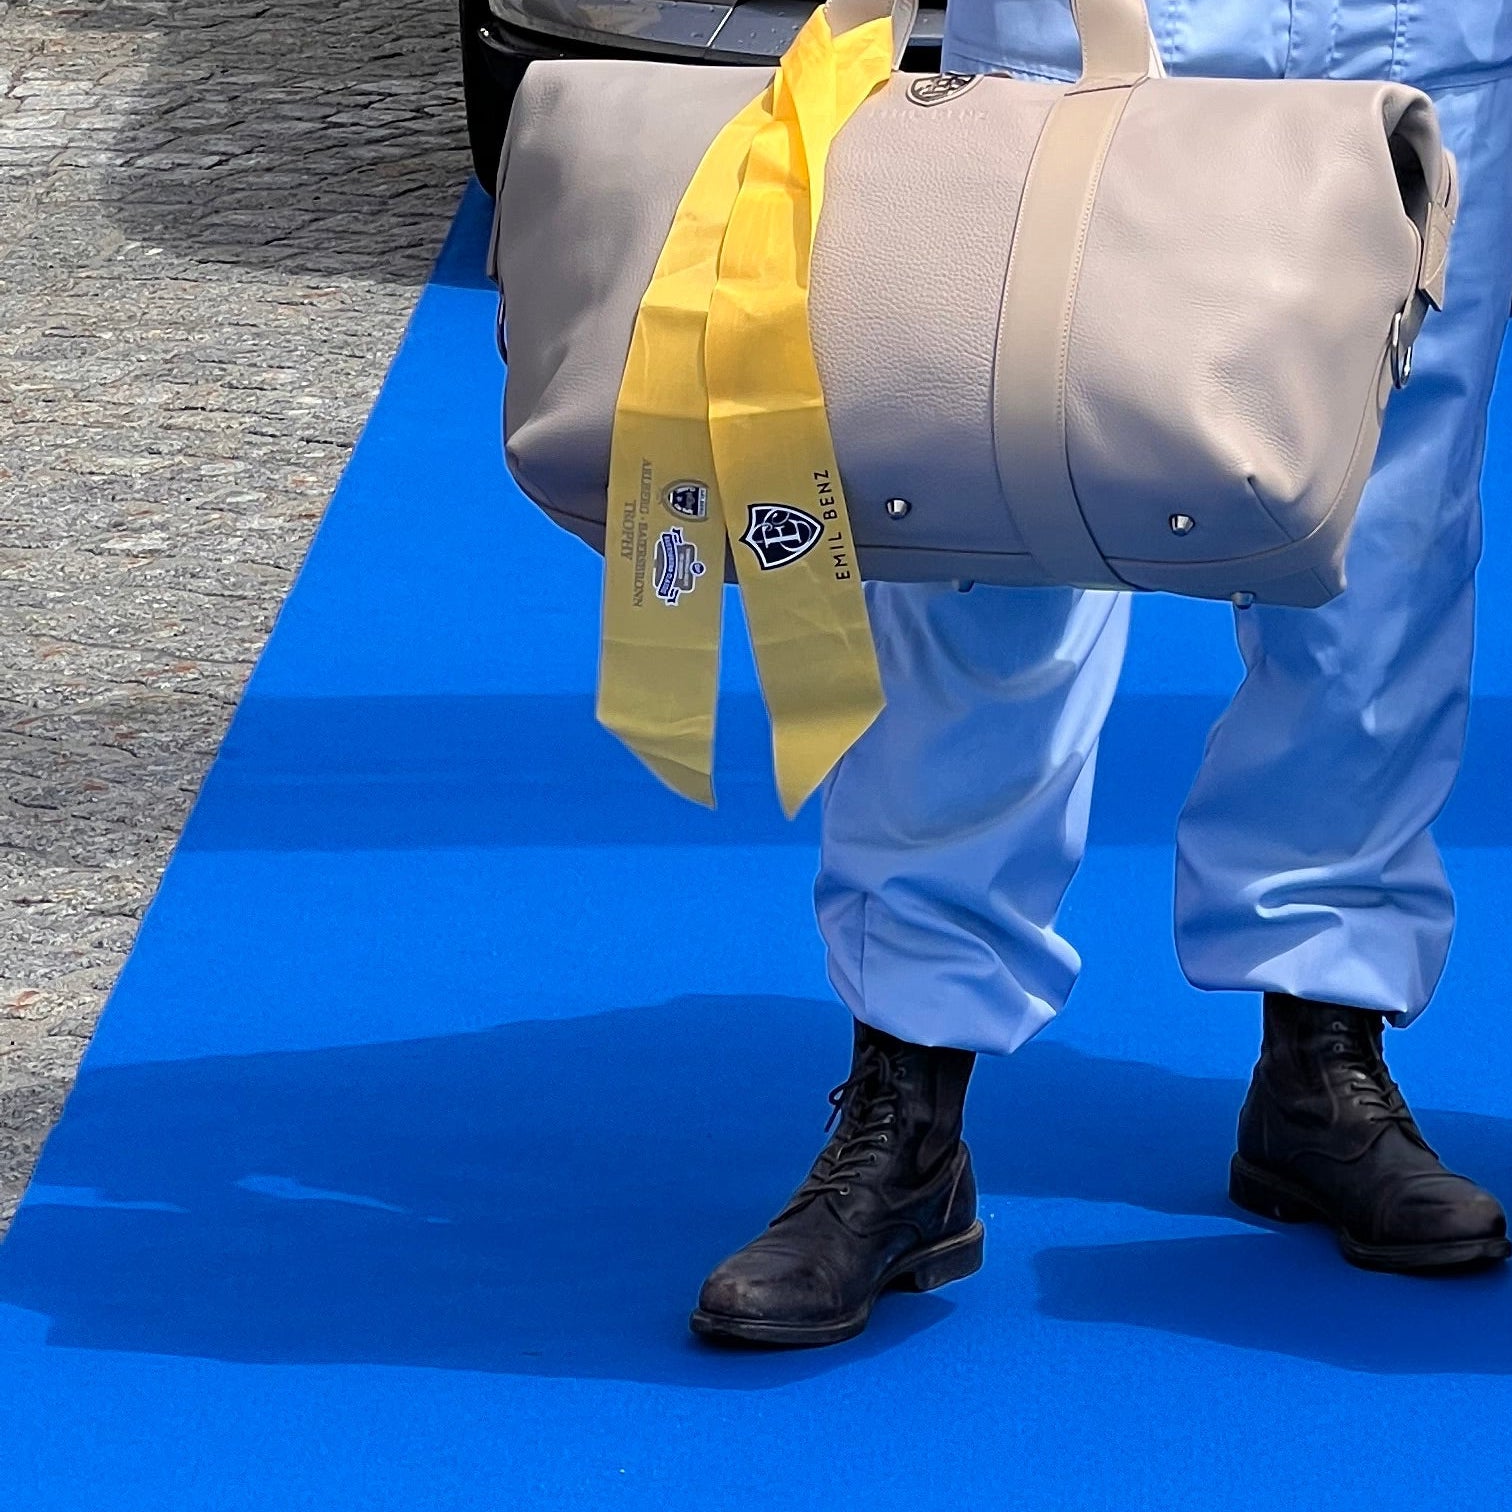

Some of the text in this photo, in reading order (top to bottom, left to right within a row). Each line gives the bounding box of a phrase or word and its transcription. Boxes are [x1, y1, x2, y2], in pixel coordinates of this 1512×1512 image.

[620, 499, 637, 561] TROPHY
[813, 469, 851, 580] EMIL BENZ
